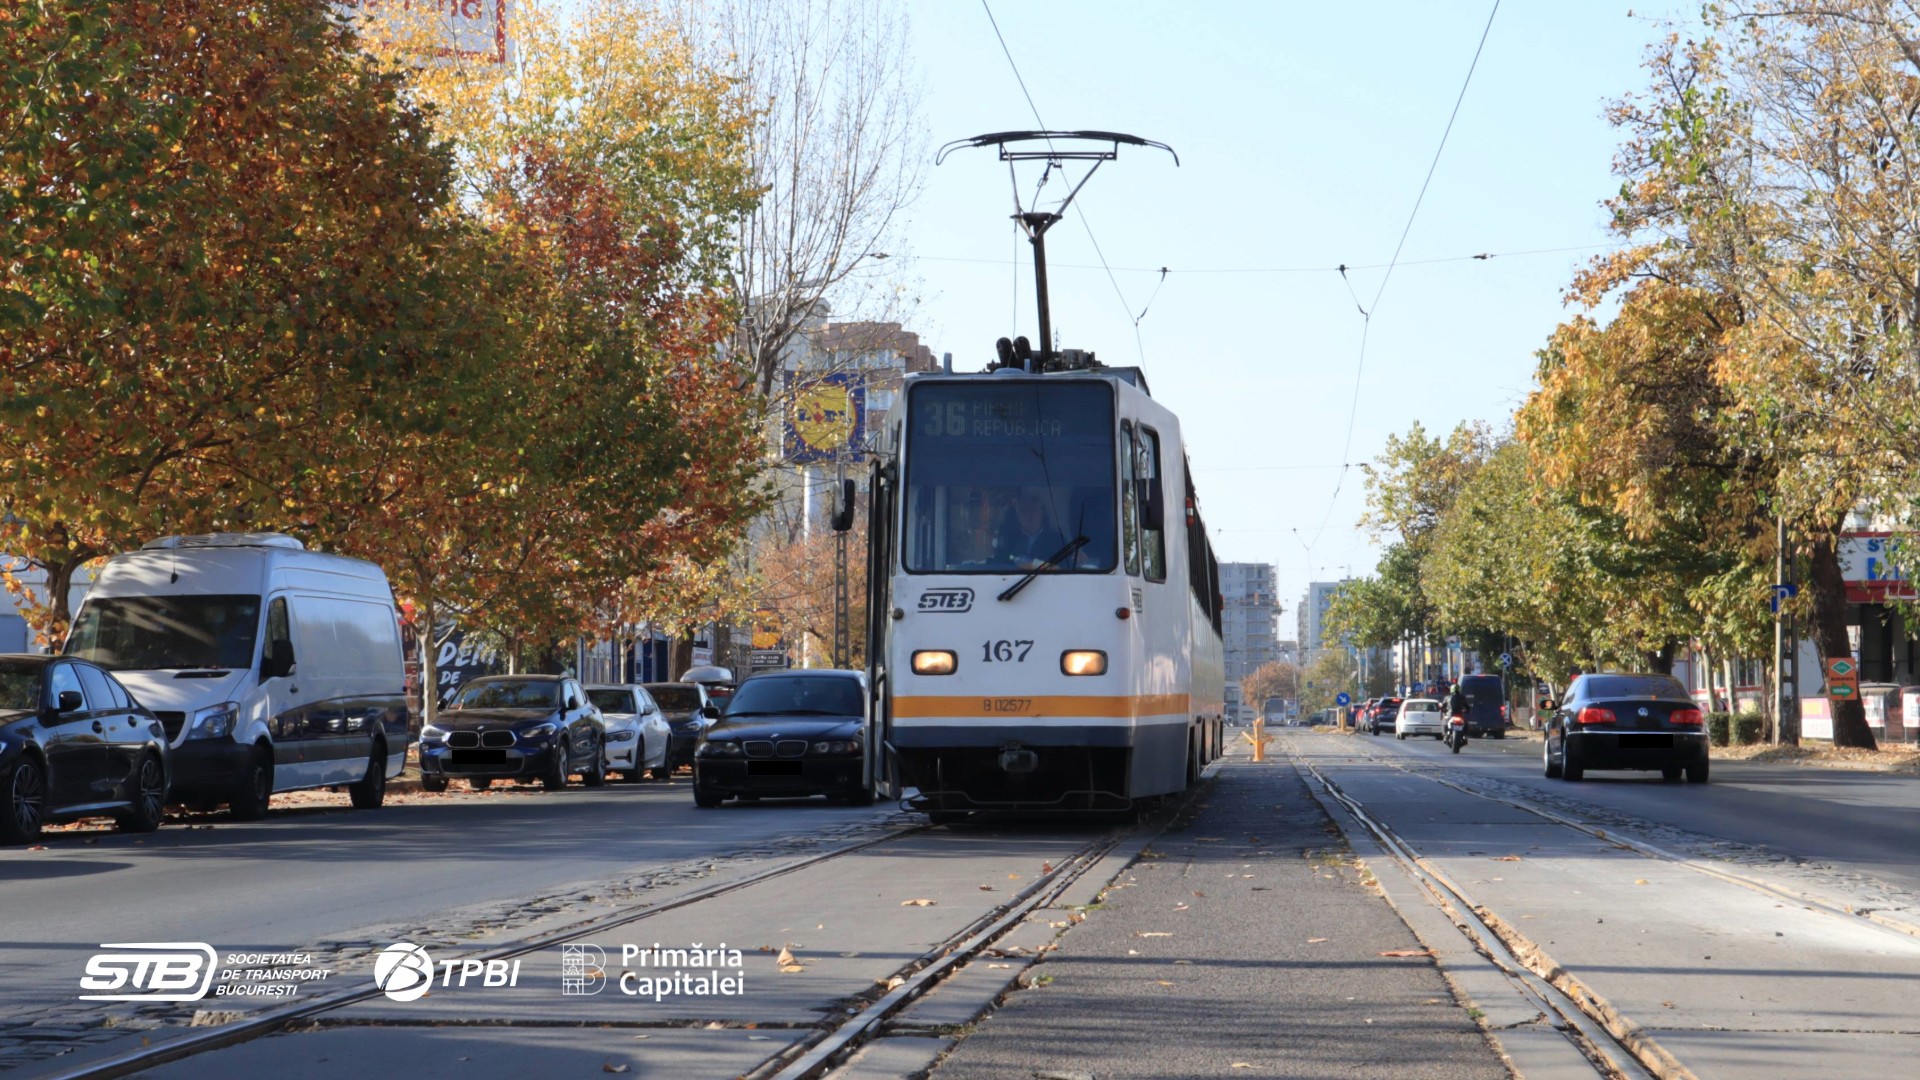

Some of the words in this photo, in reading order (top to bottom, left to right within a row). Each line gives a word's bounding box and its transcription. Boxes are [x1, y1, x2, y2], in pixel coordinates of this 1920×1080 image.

[924, 401, 966, 436] 36
[918, 592, 969, 609] STB
[982, 640, 1034, 662] 167
[983, 700, 991, 711] B
[995, 700, 1031, 711] 02577
